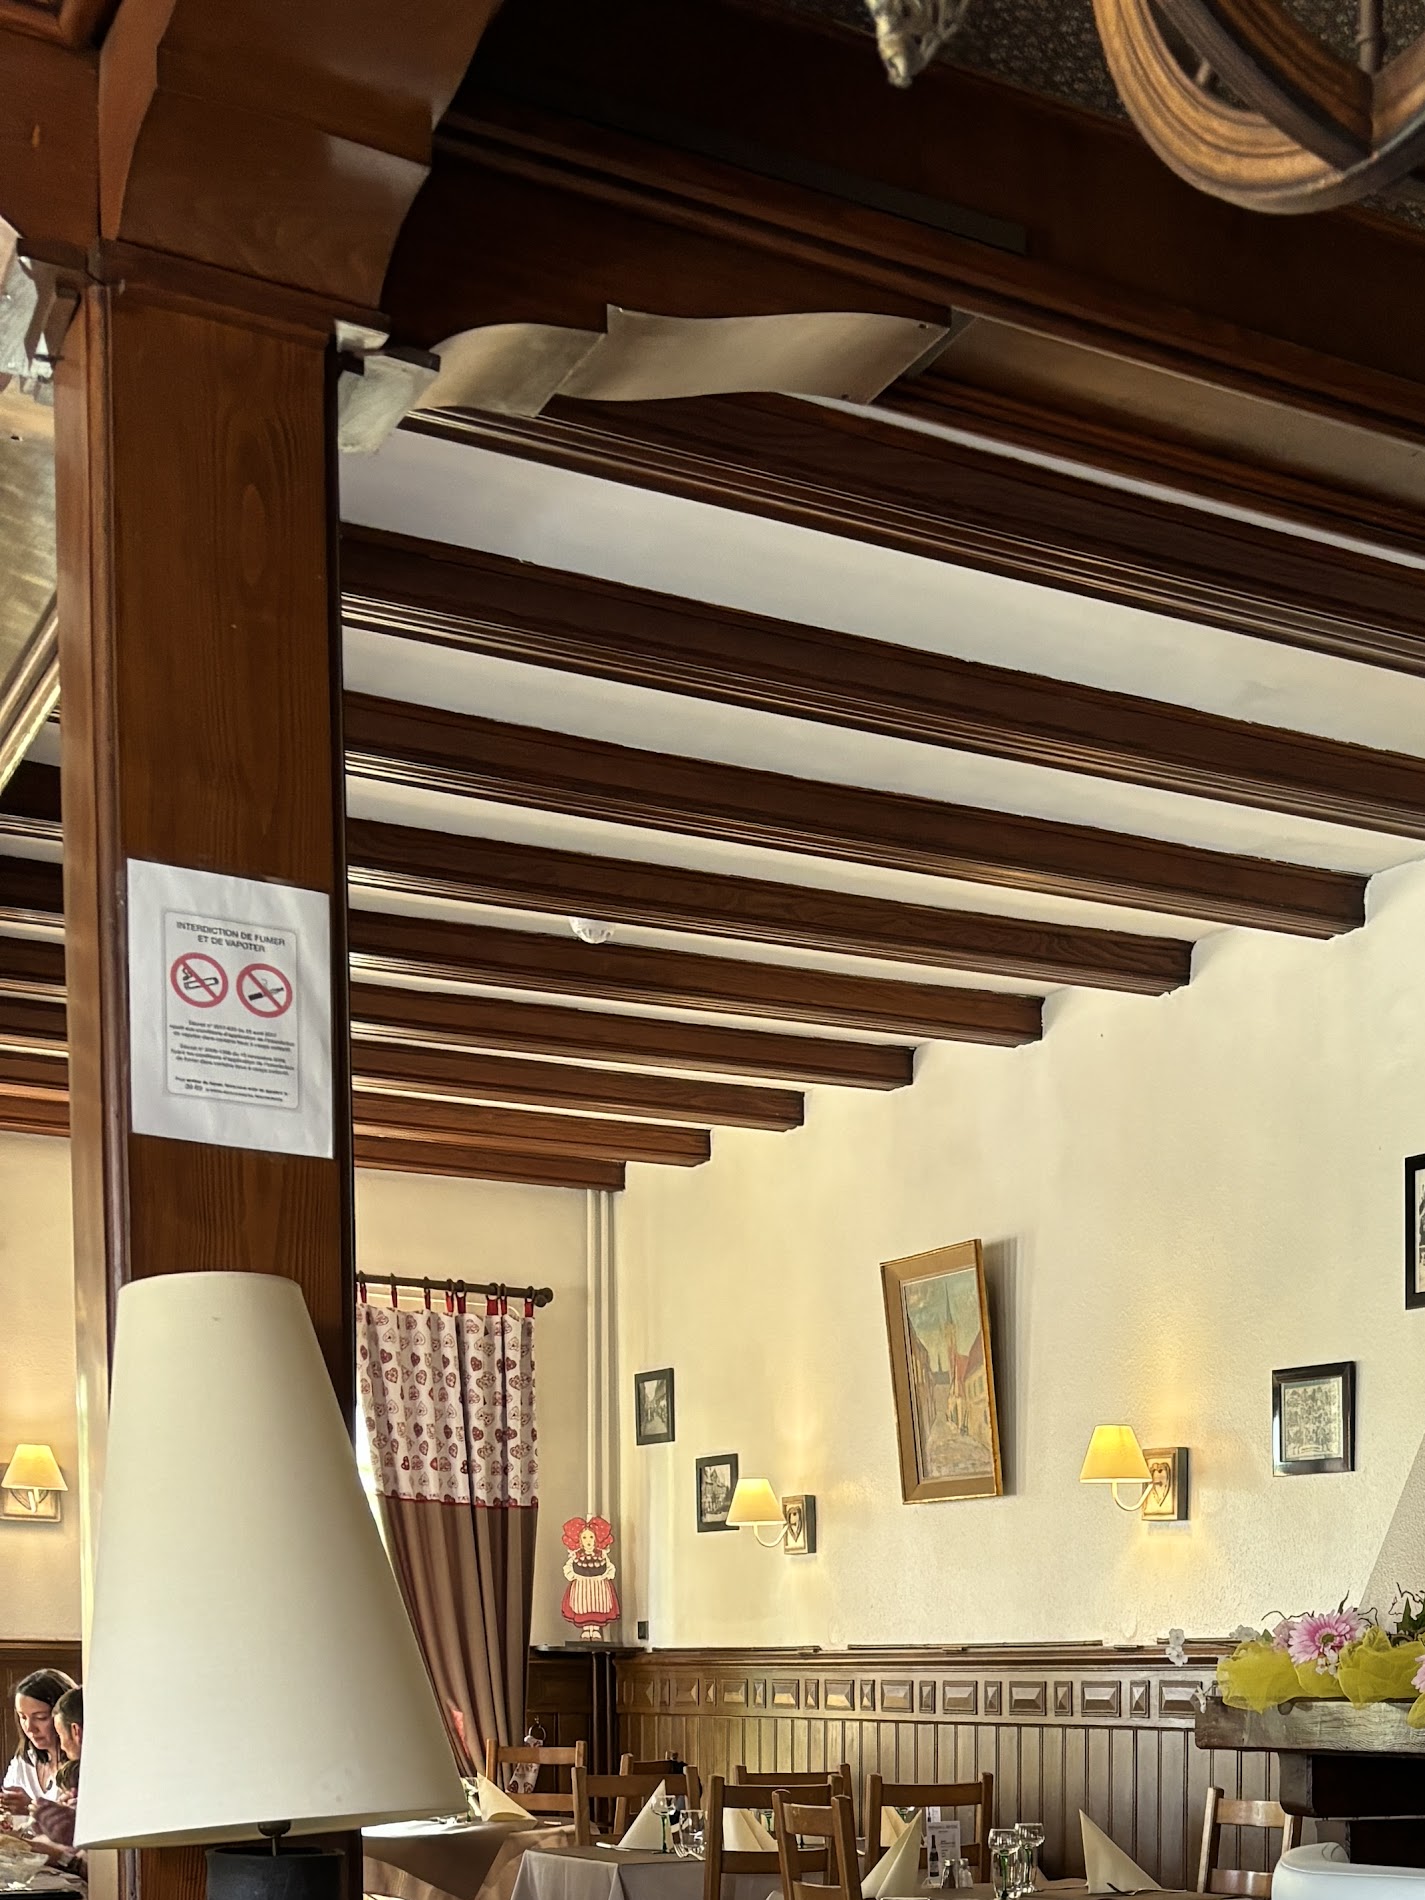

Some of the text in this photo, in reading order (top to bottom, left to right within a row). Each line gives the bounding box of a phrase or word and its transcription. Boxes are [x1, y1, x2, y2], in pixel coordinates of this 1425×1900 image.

[176, 921, 286, 947] INTERDICTION DE FUMER
[197, 934, 266, 953] ET DE VAPOTER
